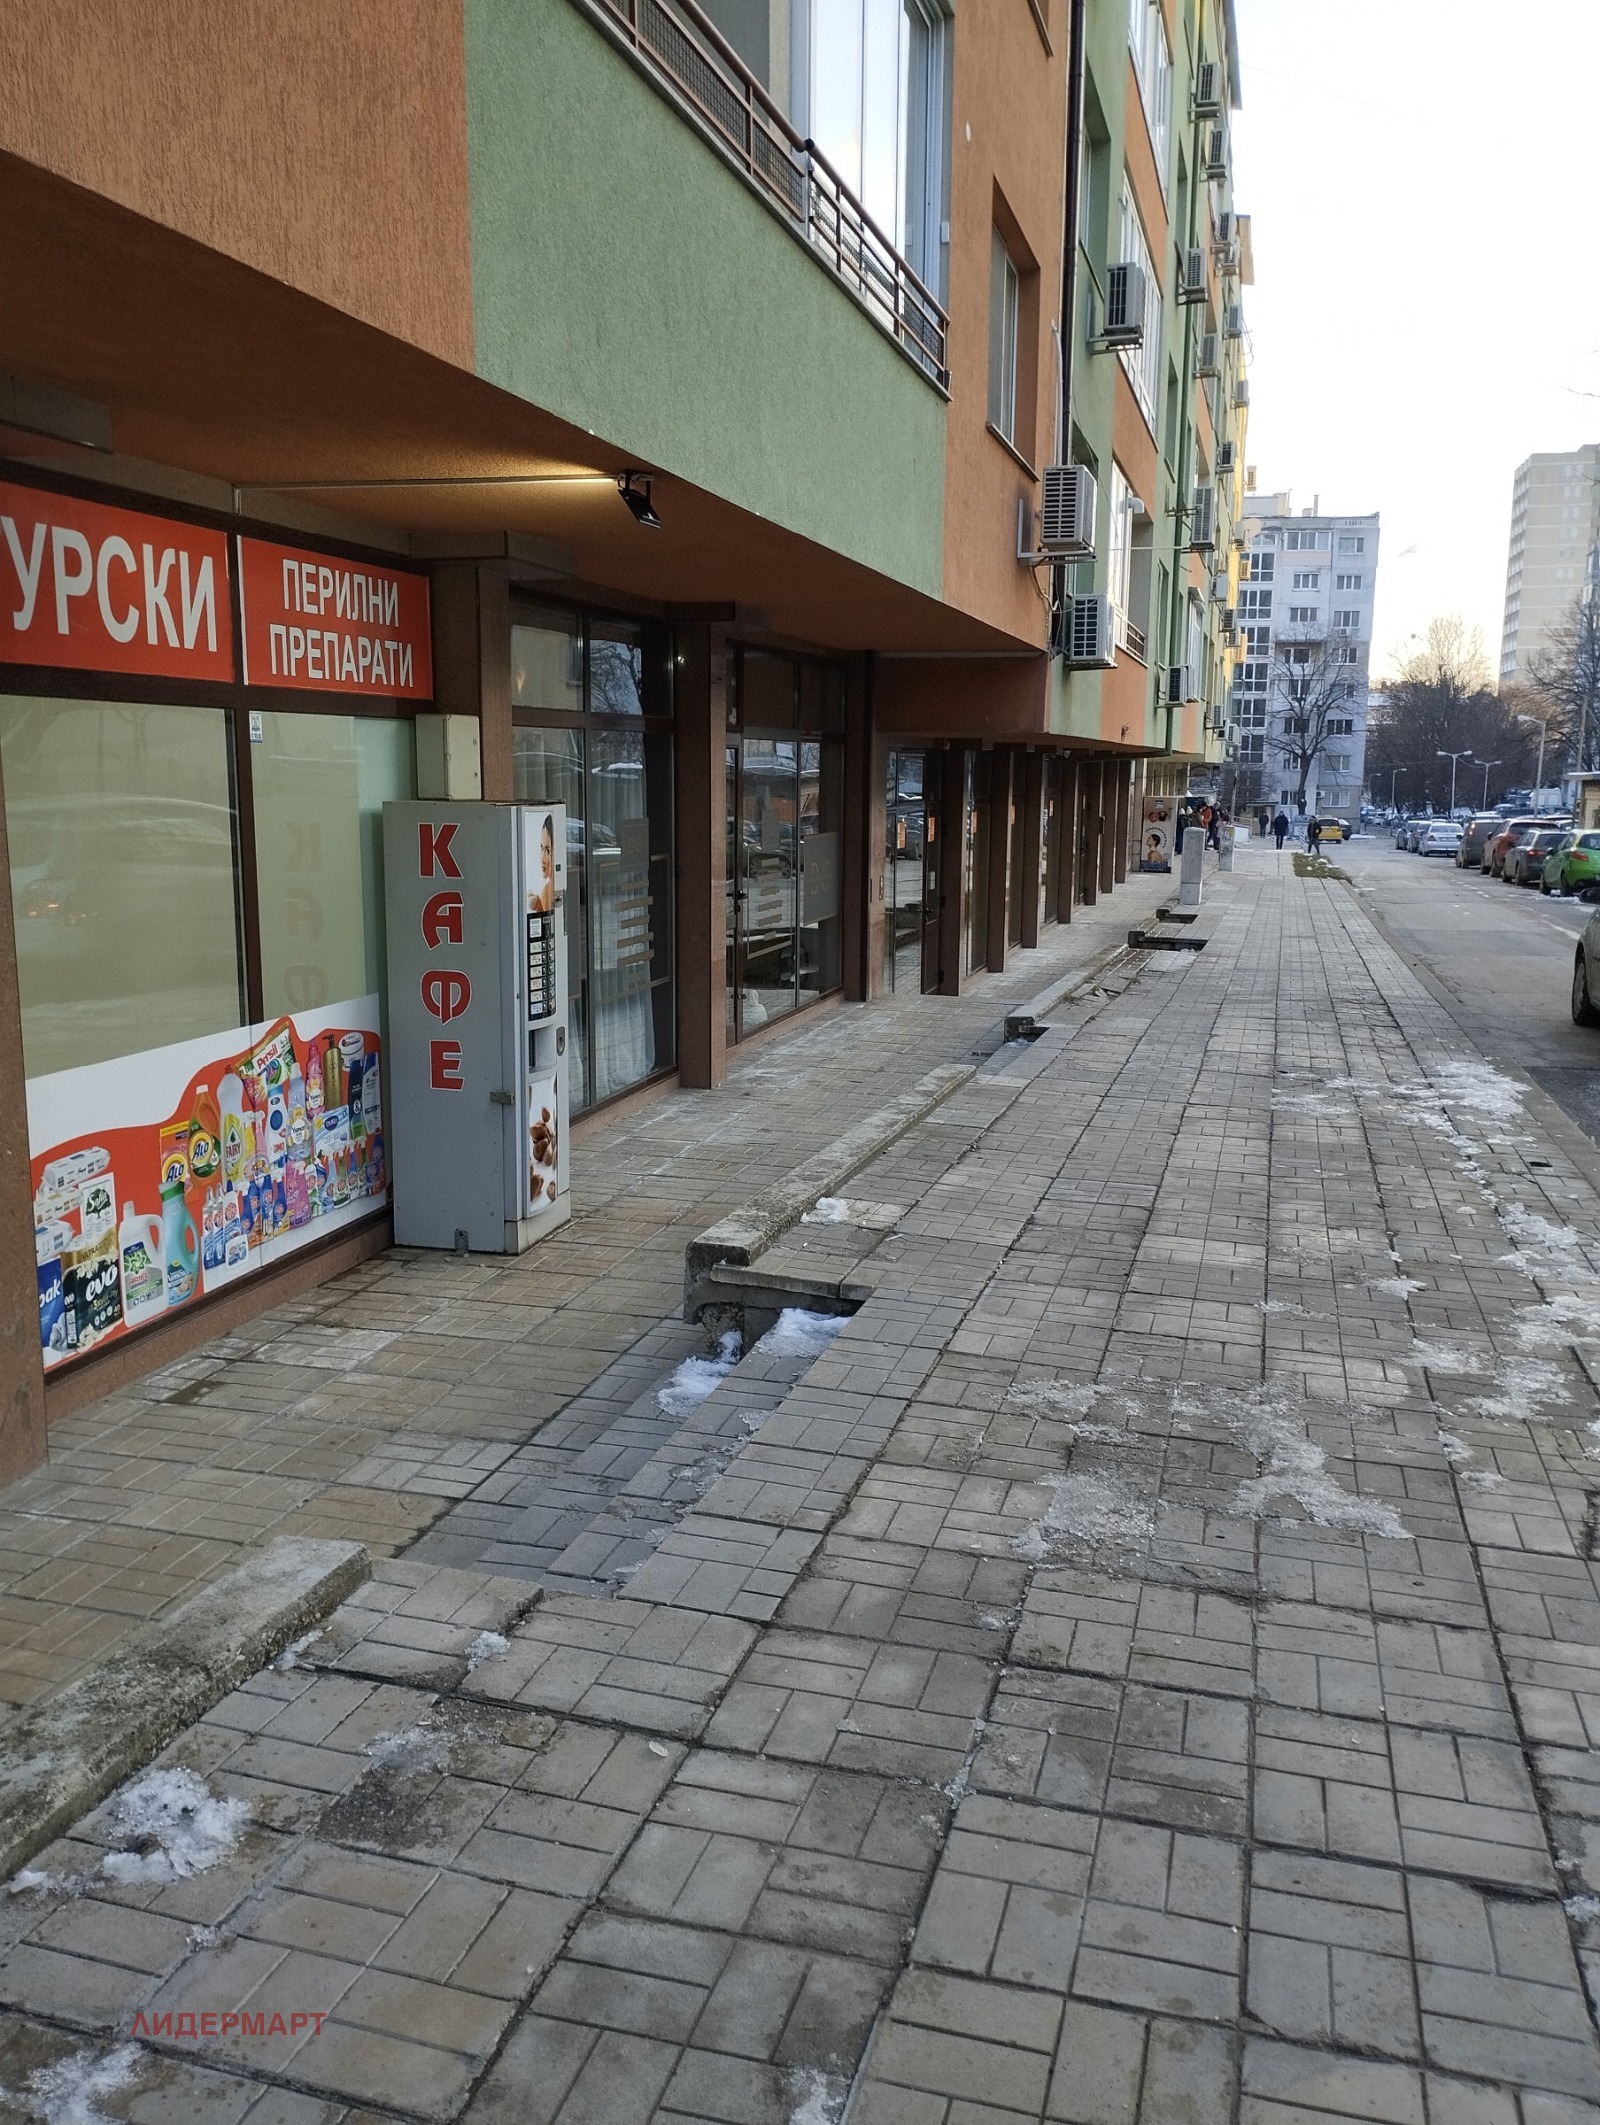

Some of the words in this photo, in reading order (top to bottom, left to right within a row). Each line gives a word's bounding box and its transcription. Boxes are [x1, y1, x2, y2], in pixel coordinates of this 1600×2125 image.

[0, 515, 218, 653] УРСКИ
[282, 558, 400, 628] ПЕРИЛНИ
[269, 623, 414, 688] ПРЕПАРАТИ
[417, 822, 473, 1092] КАФЕ
[256, 1044, 279, 1069] Persil
[225, 1141, 241, 1157] FAIRY
[85, 1264, 118, 1301] evo
[129, 1273, 148, 1285] ARIEL
